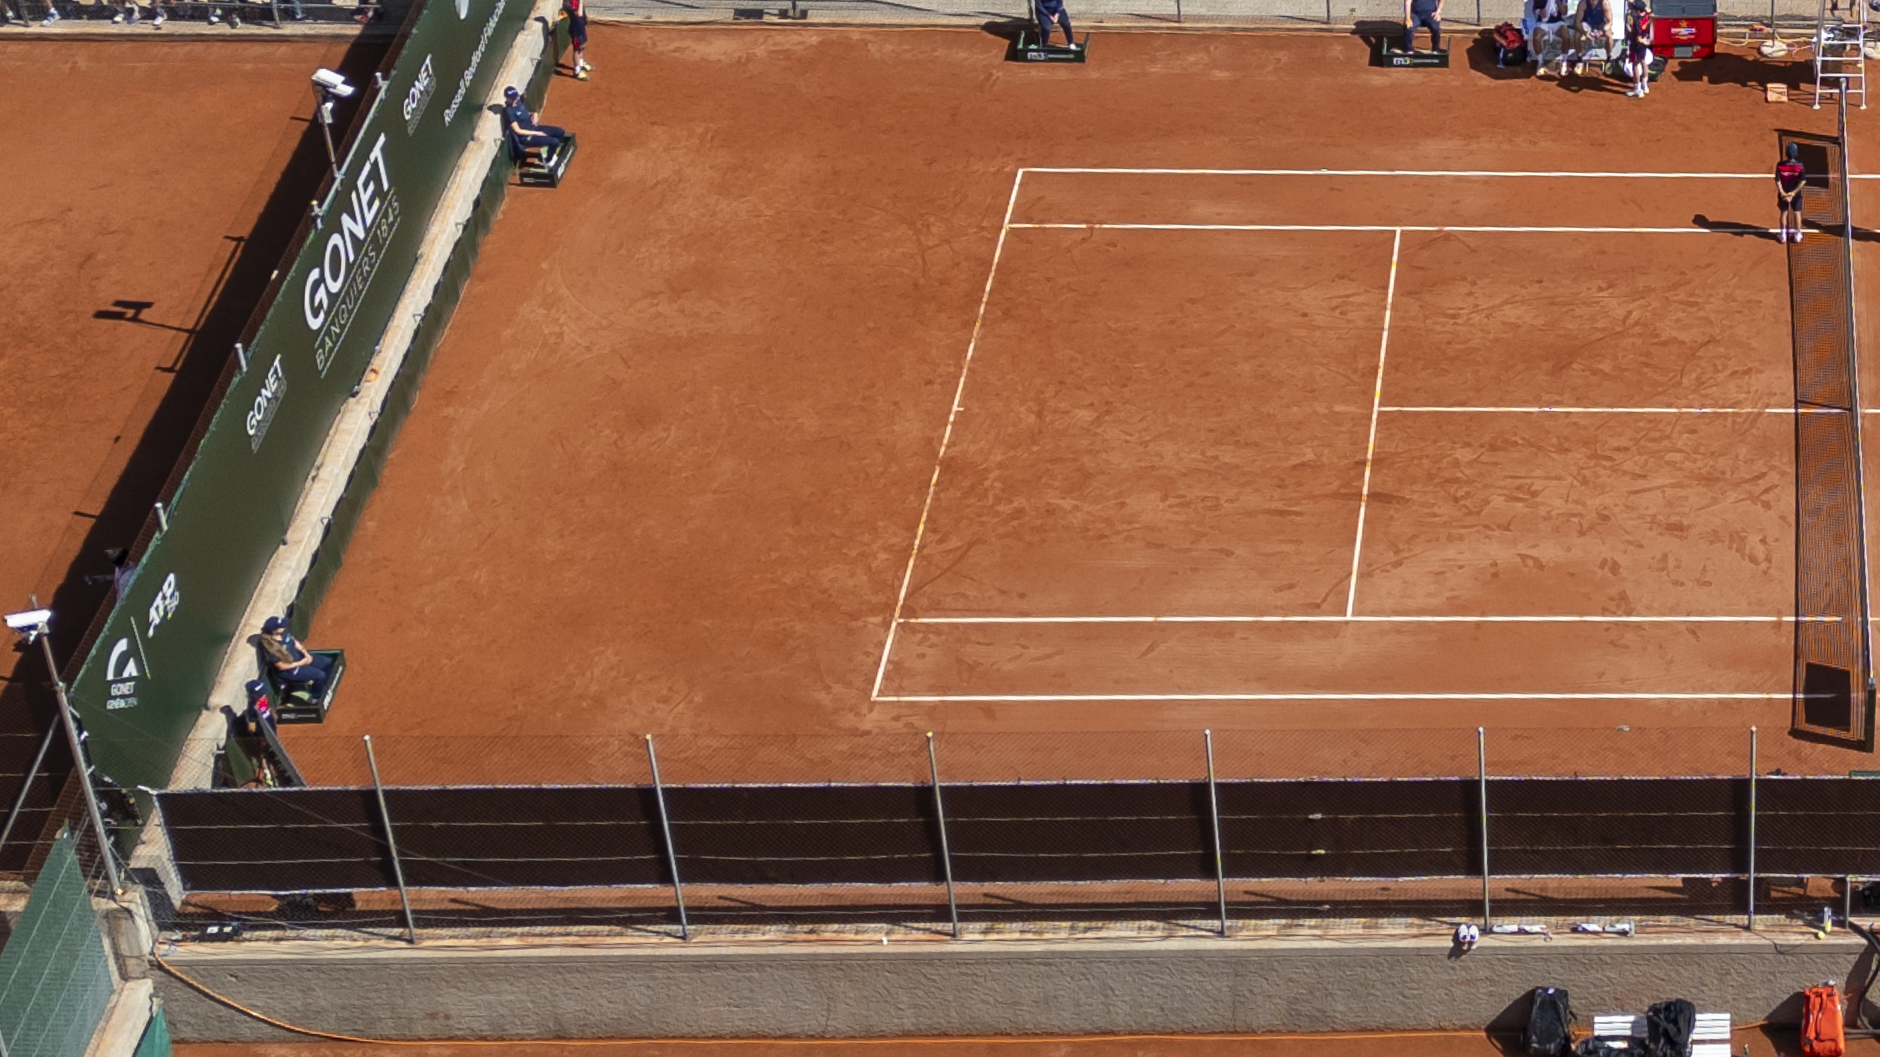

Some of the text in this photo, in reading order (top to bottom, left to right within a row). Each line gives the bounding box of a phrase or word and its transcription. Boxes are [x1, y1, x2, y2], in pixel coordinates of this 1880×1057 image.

[403, 53, 432, 121] GONET
[304, 132, 389, 330] GONET
[315, 195, 400, 370] BANQUIERS 1845
[246, 353, 283, 436] GONET
